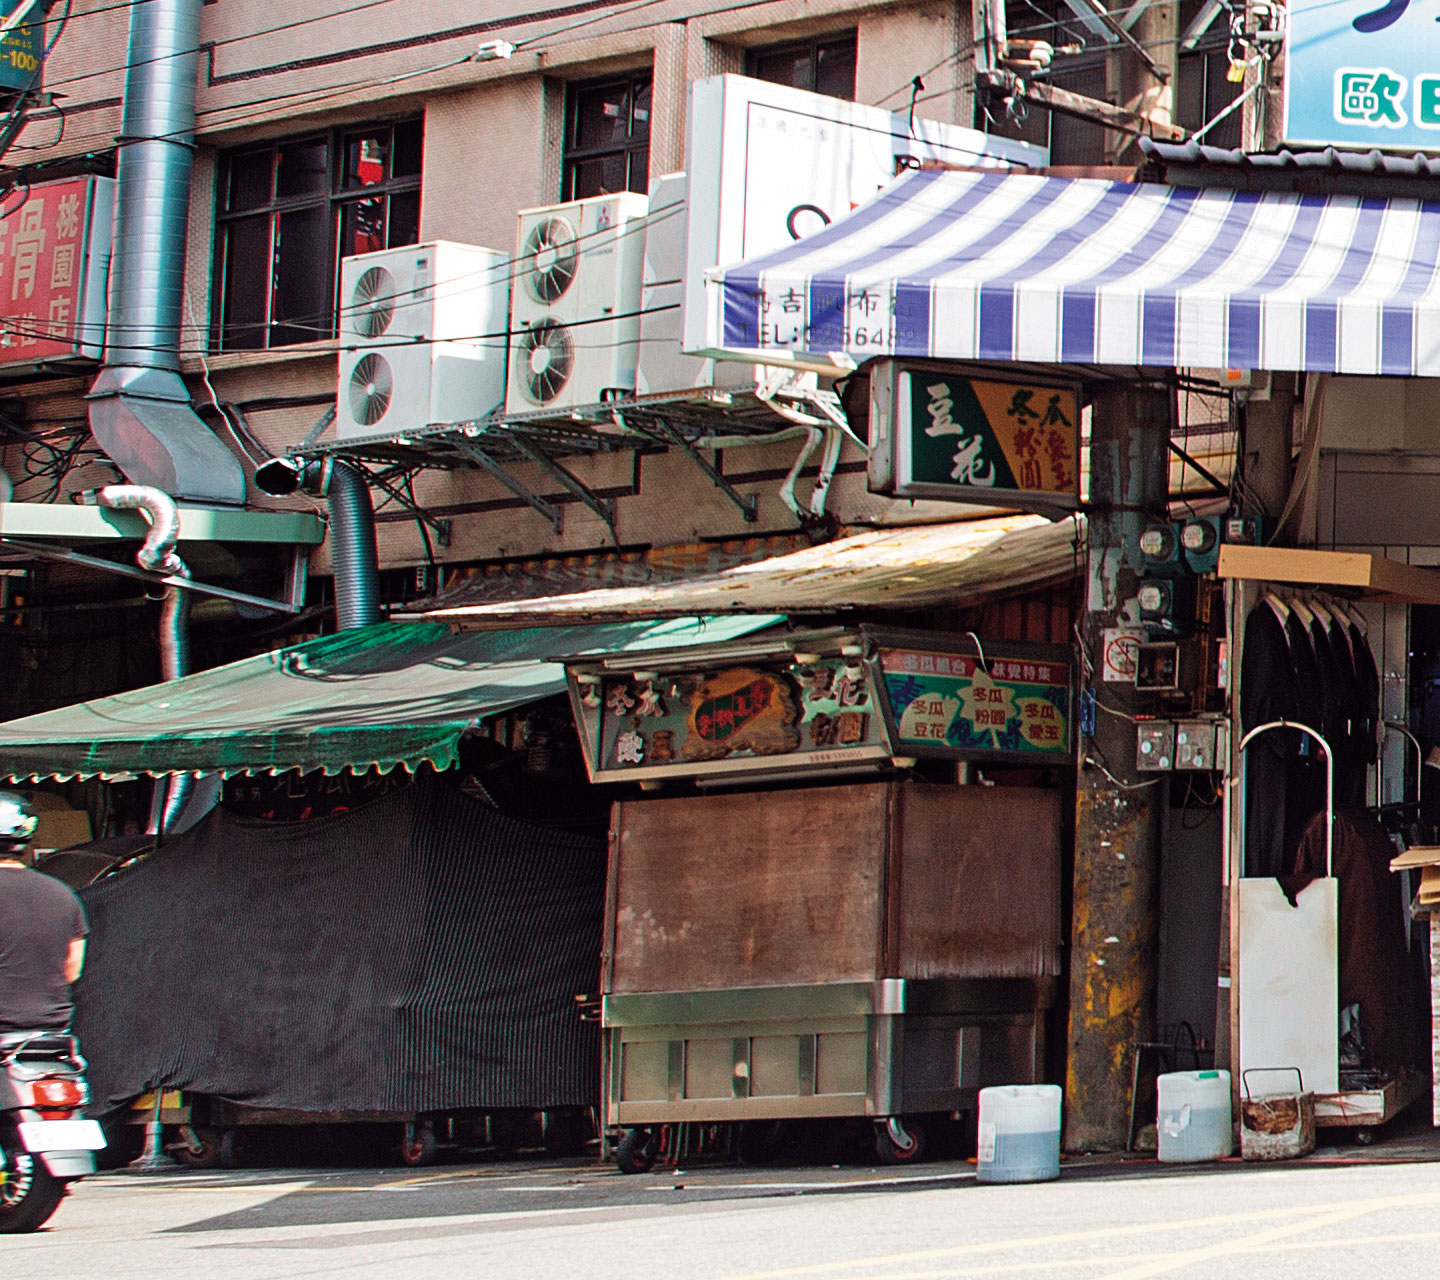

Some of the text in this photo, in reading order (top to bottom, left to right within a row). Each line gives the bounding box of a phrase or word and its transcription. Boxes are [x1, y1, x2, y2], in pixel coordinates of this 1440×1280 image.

[48, 193, 81, 338] 桃園店
[924, 381, 997, 488] 豆花
[912, 700, 945, 717] 冬瓜
[914, 721, 946, 739] 豆花
